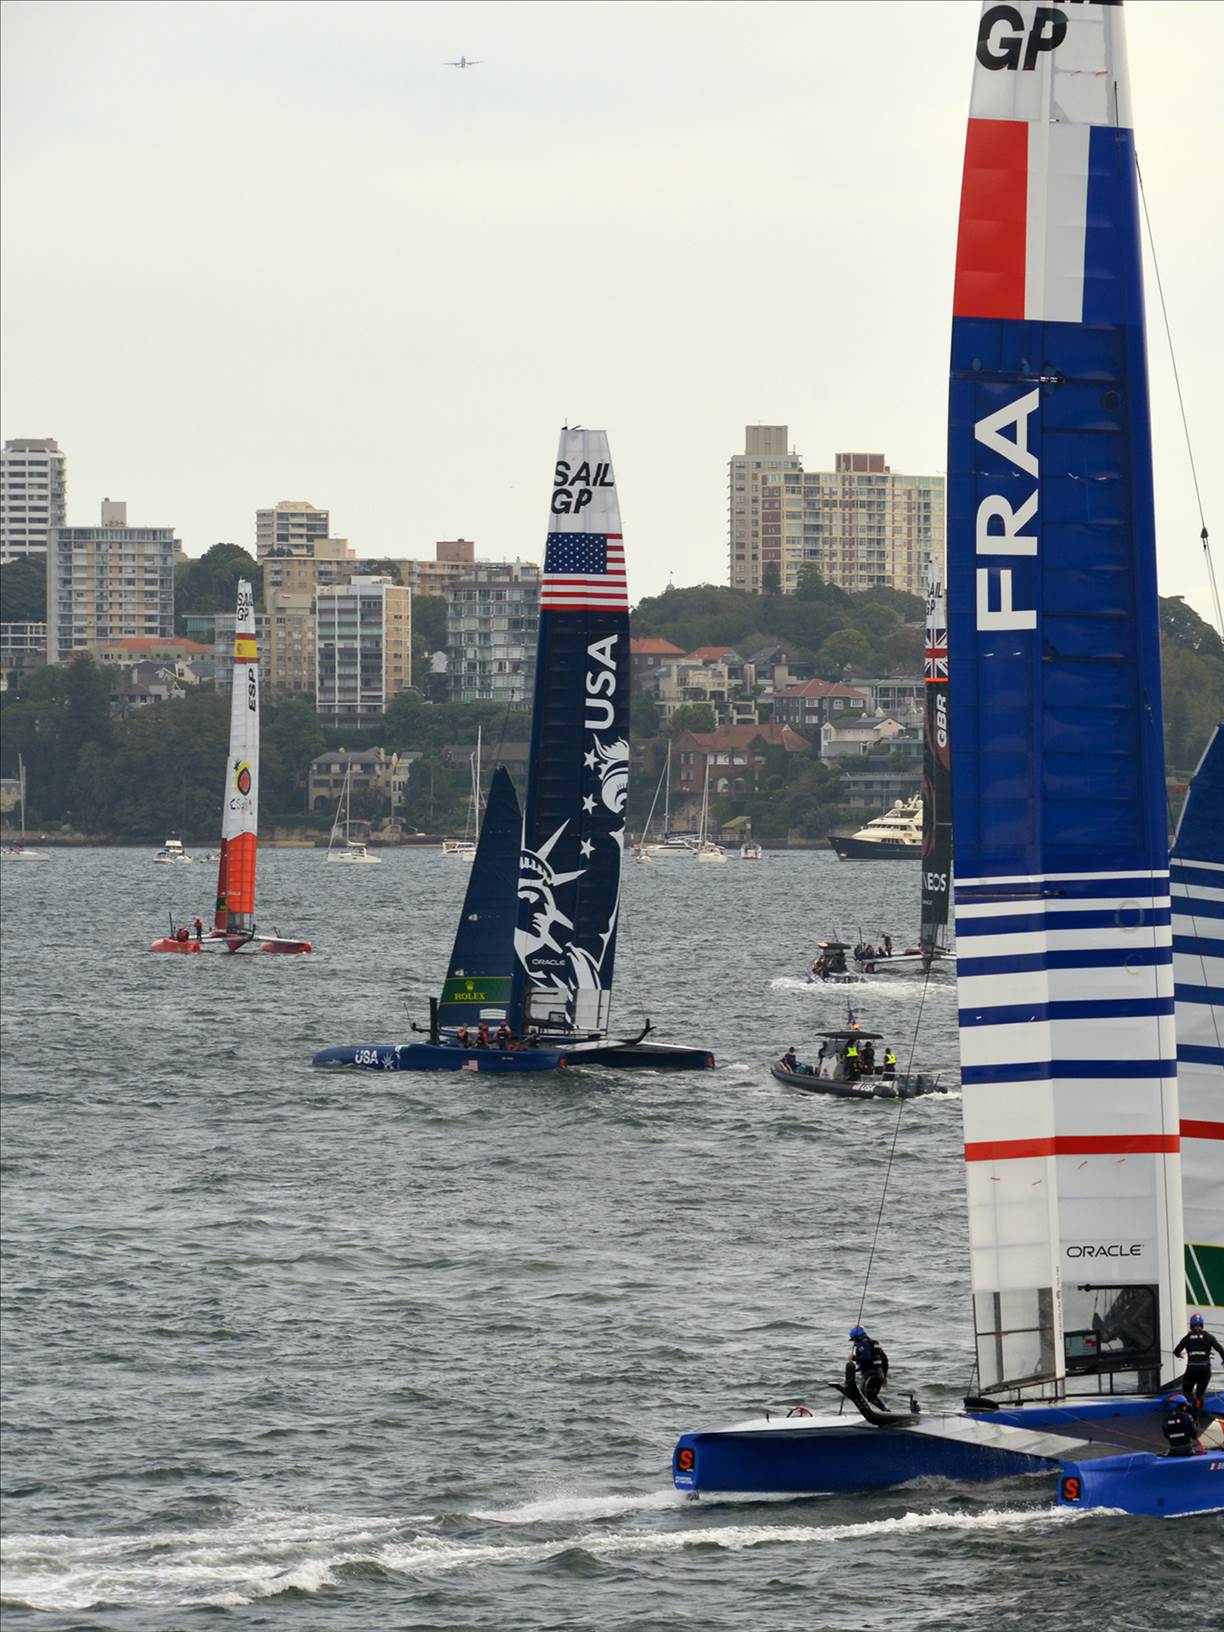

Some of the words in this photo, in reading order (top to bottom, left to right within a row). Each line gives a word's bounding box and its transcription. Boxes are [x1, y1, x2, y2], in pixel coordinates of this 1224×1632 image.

[976, 4, 1069, 71] GP
[554, 460, 615, 487] SAIL
[551, 488, 593, 514] GP
[975, 387, 1040, 631] FRA
[584, 634, 619, 730] USA
[936, 694, 947, 748] GBR
[454, 992, 486, 1000] ROLEX
[355, 1050, 379, 1065] USA
[1066, 1244, 1142, 1258] ORACLE
[680, 1449, 693, 1471] S
[1064, 1478, 1079, 1500] S
